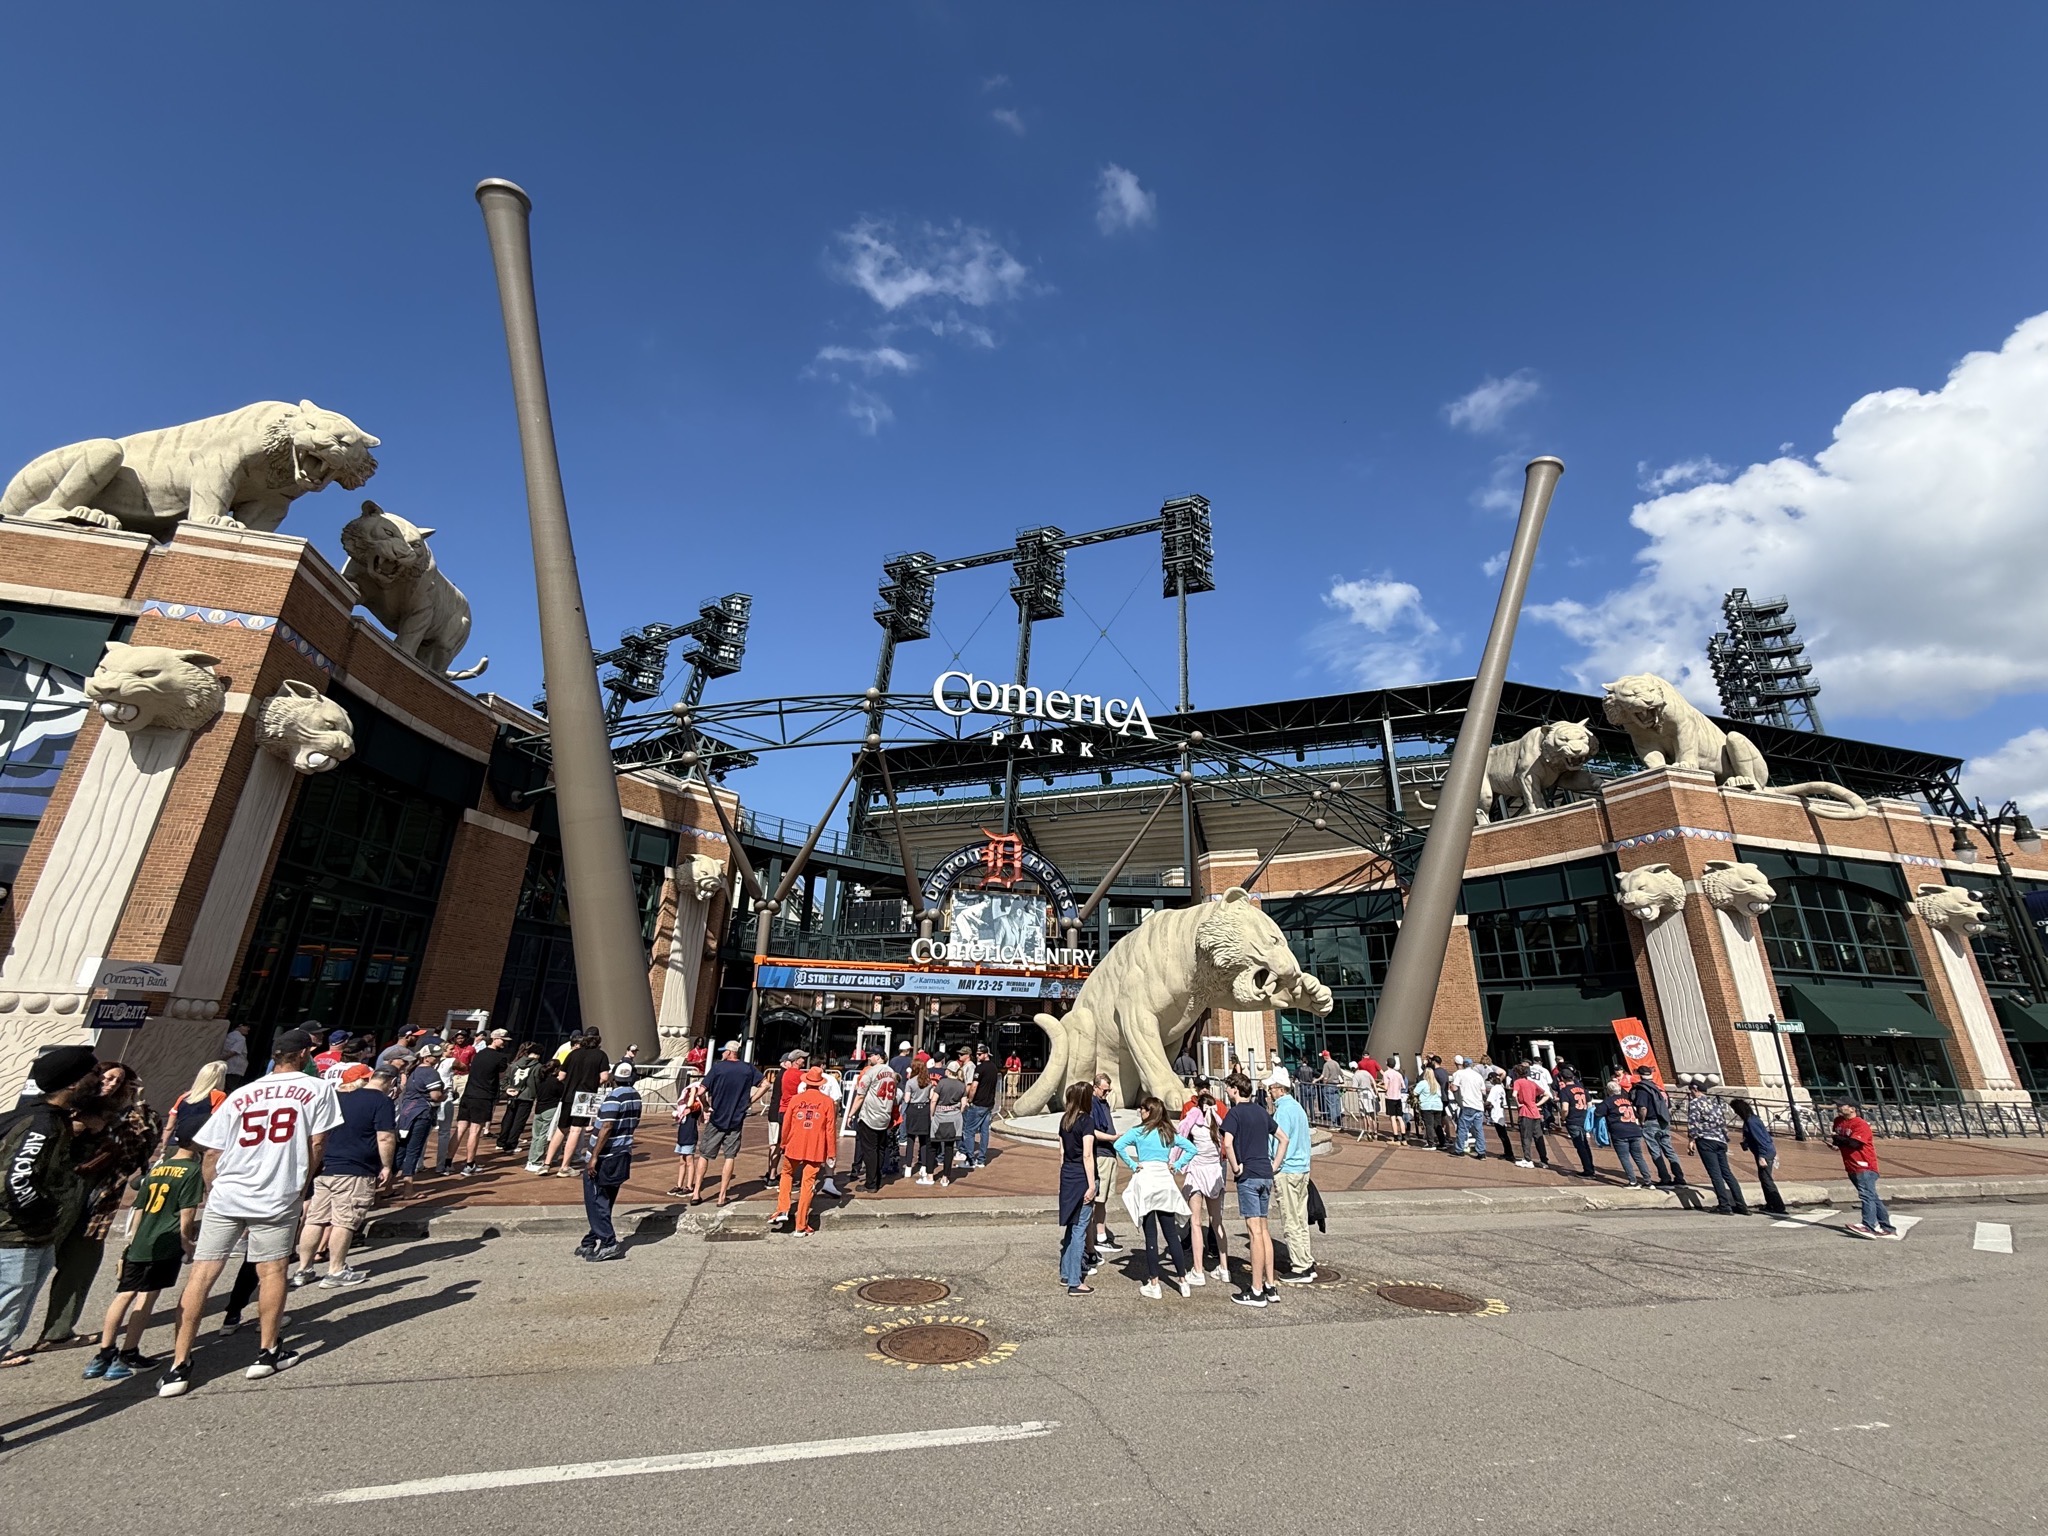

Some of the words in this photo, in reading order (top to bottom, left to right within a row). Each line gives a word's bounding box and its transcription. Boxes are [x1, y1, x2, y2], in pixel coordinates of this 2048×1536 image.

[991, 731, 1094, 758] PARK
[925, 847, 982, 901] DETROIT
[1028, 855, 1073, 910] TIGERS
[1034, 947, 1096, 967] ENTRY
[147, 976, 168, 987] Bank
[839, 975, 858, 985] OUT
[858, 976, 891, 986] CANCER
[918, 977, 951, 986] Karmanos
[957, 979, 977, 990] MAY
[977, 980, 1003, 991] 23-25
[98, 1004, 115, 1019] VIP
[124, 1005, 149, 1020] GATE
[1735, 1022, 1769, 1032] Michigan
[233, 1085, 316, 1112] PAPELBON
[877, 1081, 896, 1101] 49
[238, 1107, 298, 1148] 58
[19, 1131, 47, 1157] AIR
[145, 1182, 170, 1213] 16
